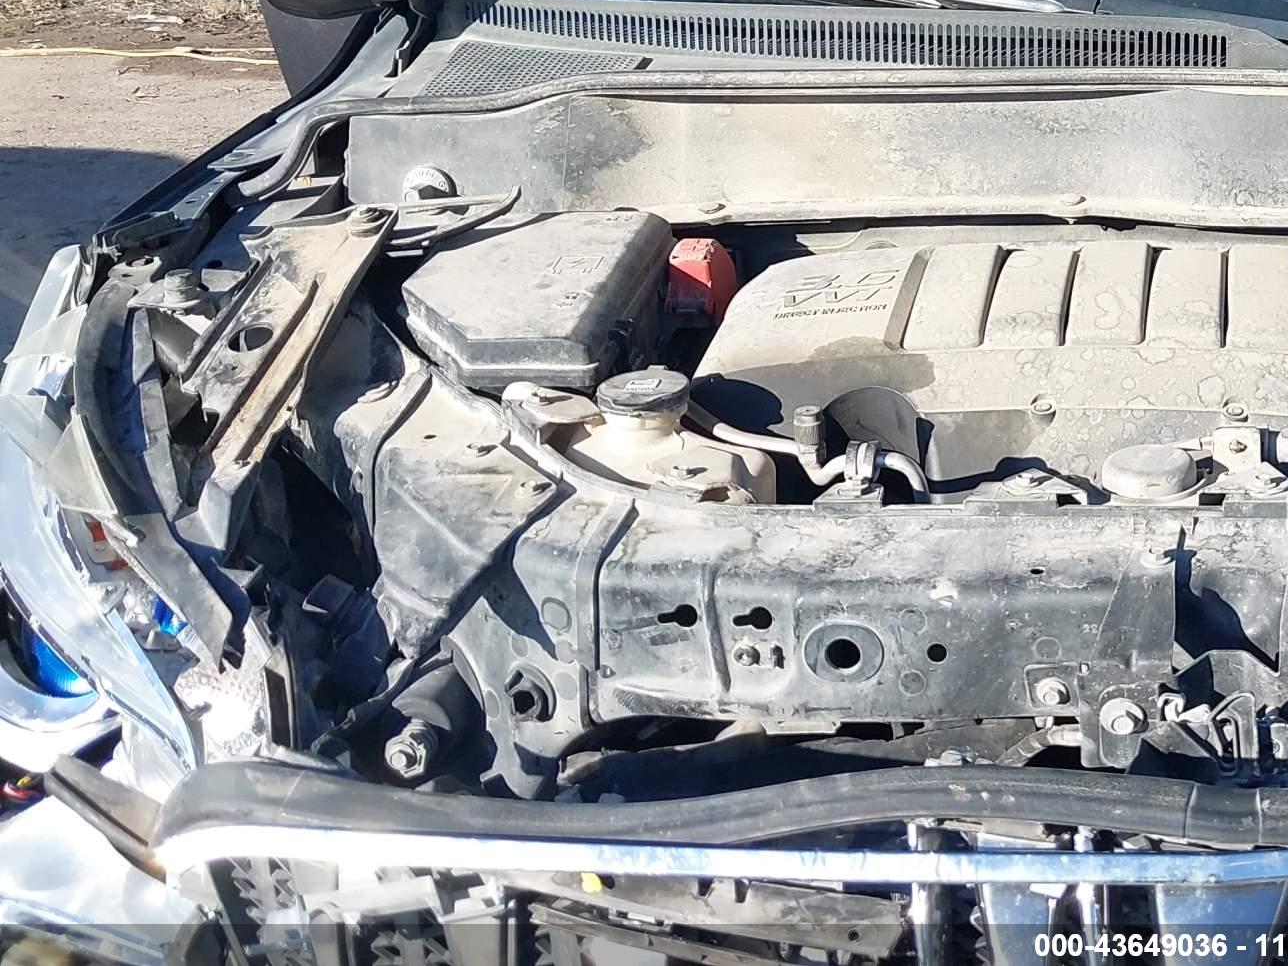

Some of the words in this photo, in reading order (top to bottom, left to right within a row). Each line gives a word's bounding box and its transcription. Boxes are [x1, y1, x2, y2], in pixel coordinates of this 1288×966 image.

[783, 287, 893, 307] VVT
[773, 308, 818, 321] DIRECT
[820, 303, 887, 316] INJECTION
